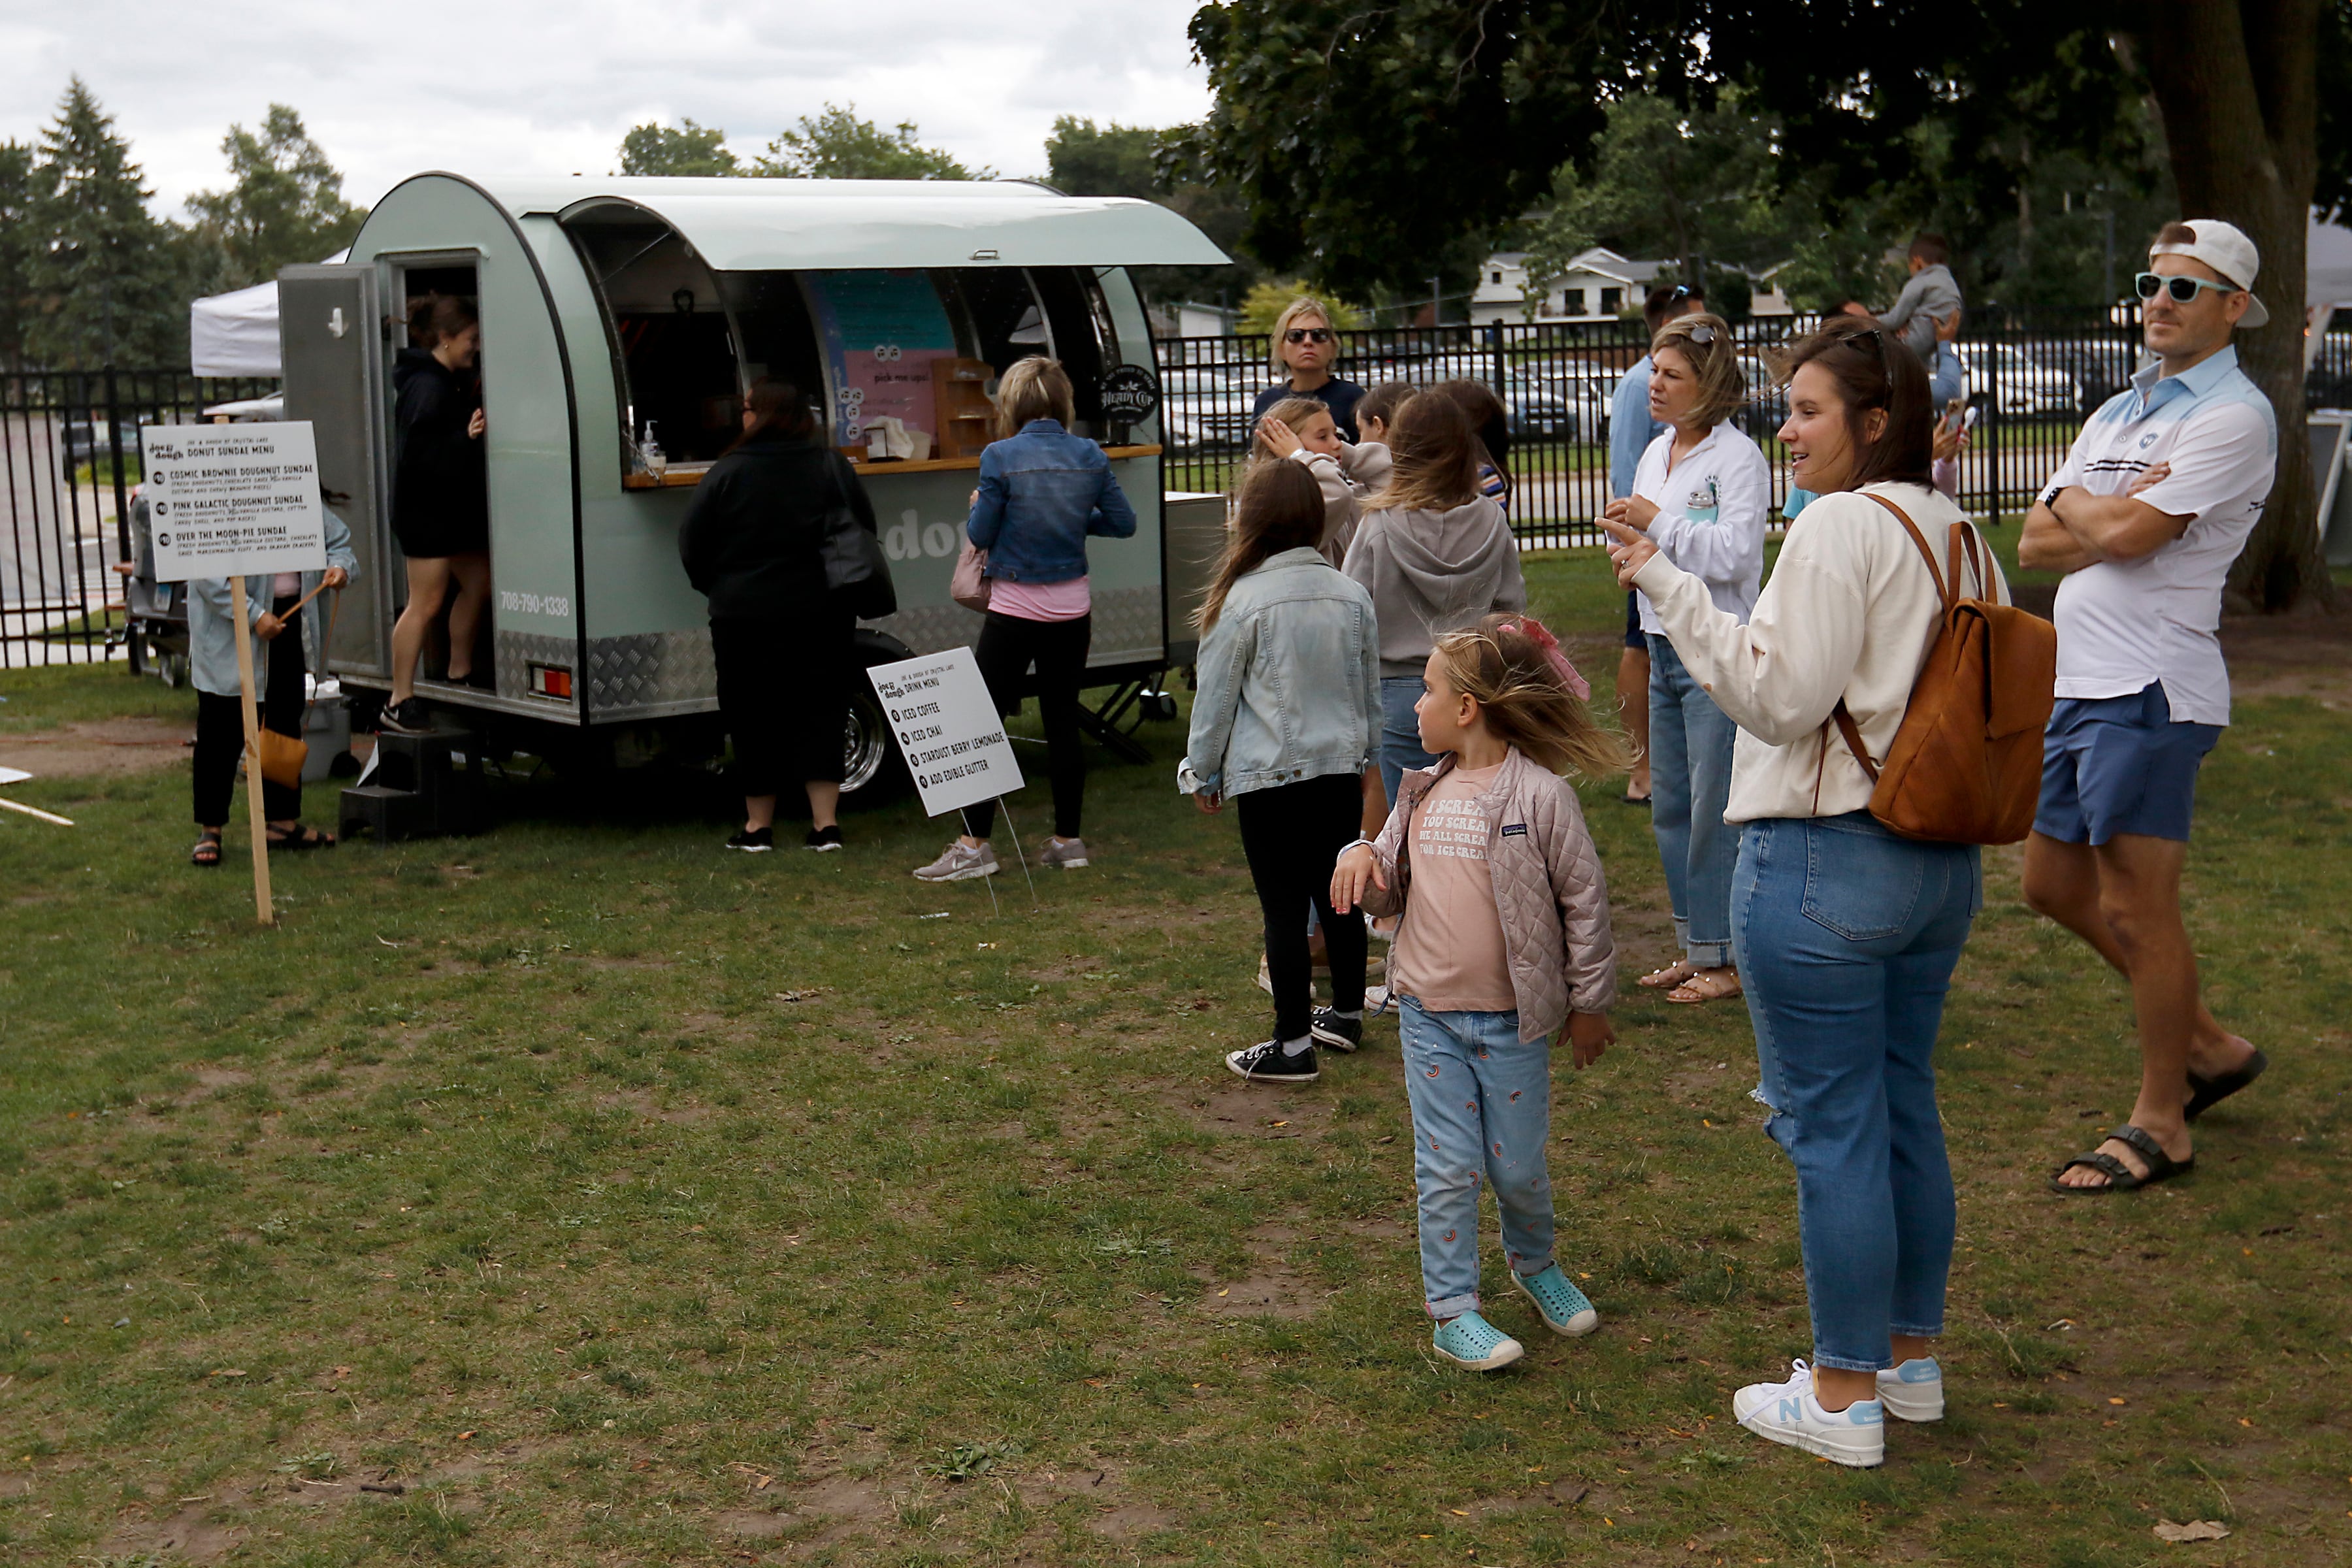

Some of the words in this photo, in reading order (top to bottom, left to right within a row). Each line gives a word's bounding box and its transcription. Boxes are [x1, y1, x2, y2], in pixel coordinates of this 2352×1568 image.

[875, 373, 893, 385] pick
[895, 374, 909, 383] me
[155, 451, 184, 461] dough
[188, 448, 214, 457] DONUT
[218, 446, 248, 456] SUNDAE
[170, 471, 198, 480] COSMIC
[202, 469, 236, 478] BROWNIE
[240, 466, 280, 476] DOUGHNUT
[284, 465, 312, 474] SUNDAE
[194, 499, 229, 509] GALACTIC
[232, 497, 271, 508] DOUGHNUT
[274, 495, 302, 504] SUNDAE
[176, 532, 195, 542] OVER
[199, 531, 212, 540] THE
[216, 528, 253, 538] MOON-PIE
[257, 526, 286, 536] SUNDAE
[501, 591, 568, 617] 708-790-1338
[885, 687, 906, 699] dough
[904, 681, 923, 693] DRINK
[923, 678, 939, 688] MENU
[901, 708, 917, 721] ICED
[917, 702, 940, 717] COFFEE
[911, 729, 926, 742] ICED
[926, 725, 943, 738] CHAI
[920, 746, 951, 764] STARDUST
[951, 741, 971, 755] BERRY
[971, 732, 1004, 749] LEMONADE
[930, 772, 943, 785] ADD
[943, 766, 965, 781] EDIBLE
[964, 759, 989, 775] GLITTER
[1426, 800, 1435, 814] I
[1436, 799, 1486, 817] SCREA
[1422, 817, 1444, 828] YOU
[1445, 817, 1490, 834] SCREA
[1419, 830, 1431, 840] WE
[1433, 830, 1452, 841] ALL
[1454, 832, 1488, 846] SCREA
[1419, 844, 1434, 855] FOR
[1437, 845, 1455, 857] ICE
[1456, 847, 1488, 860] CREA
[1779, 1397, 1803, 1423] N
